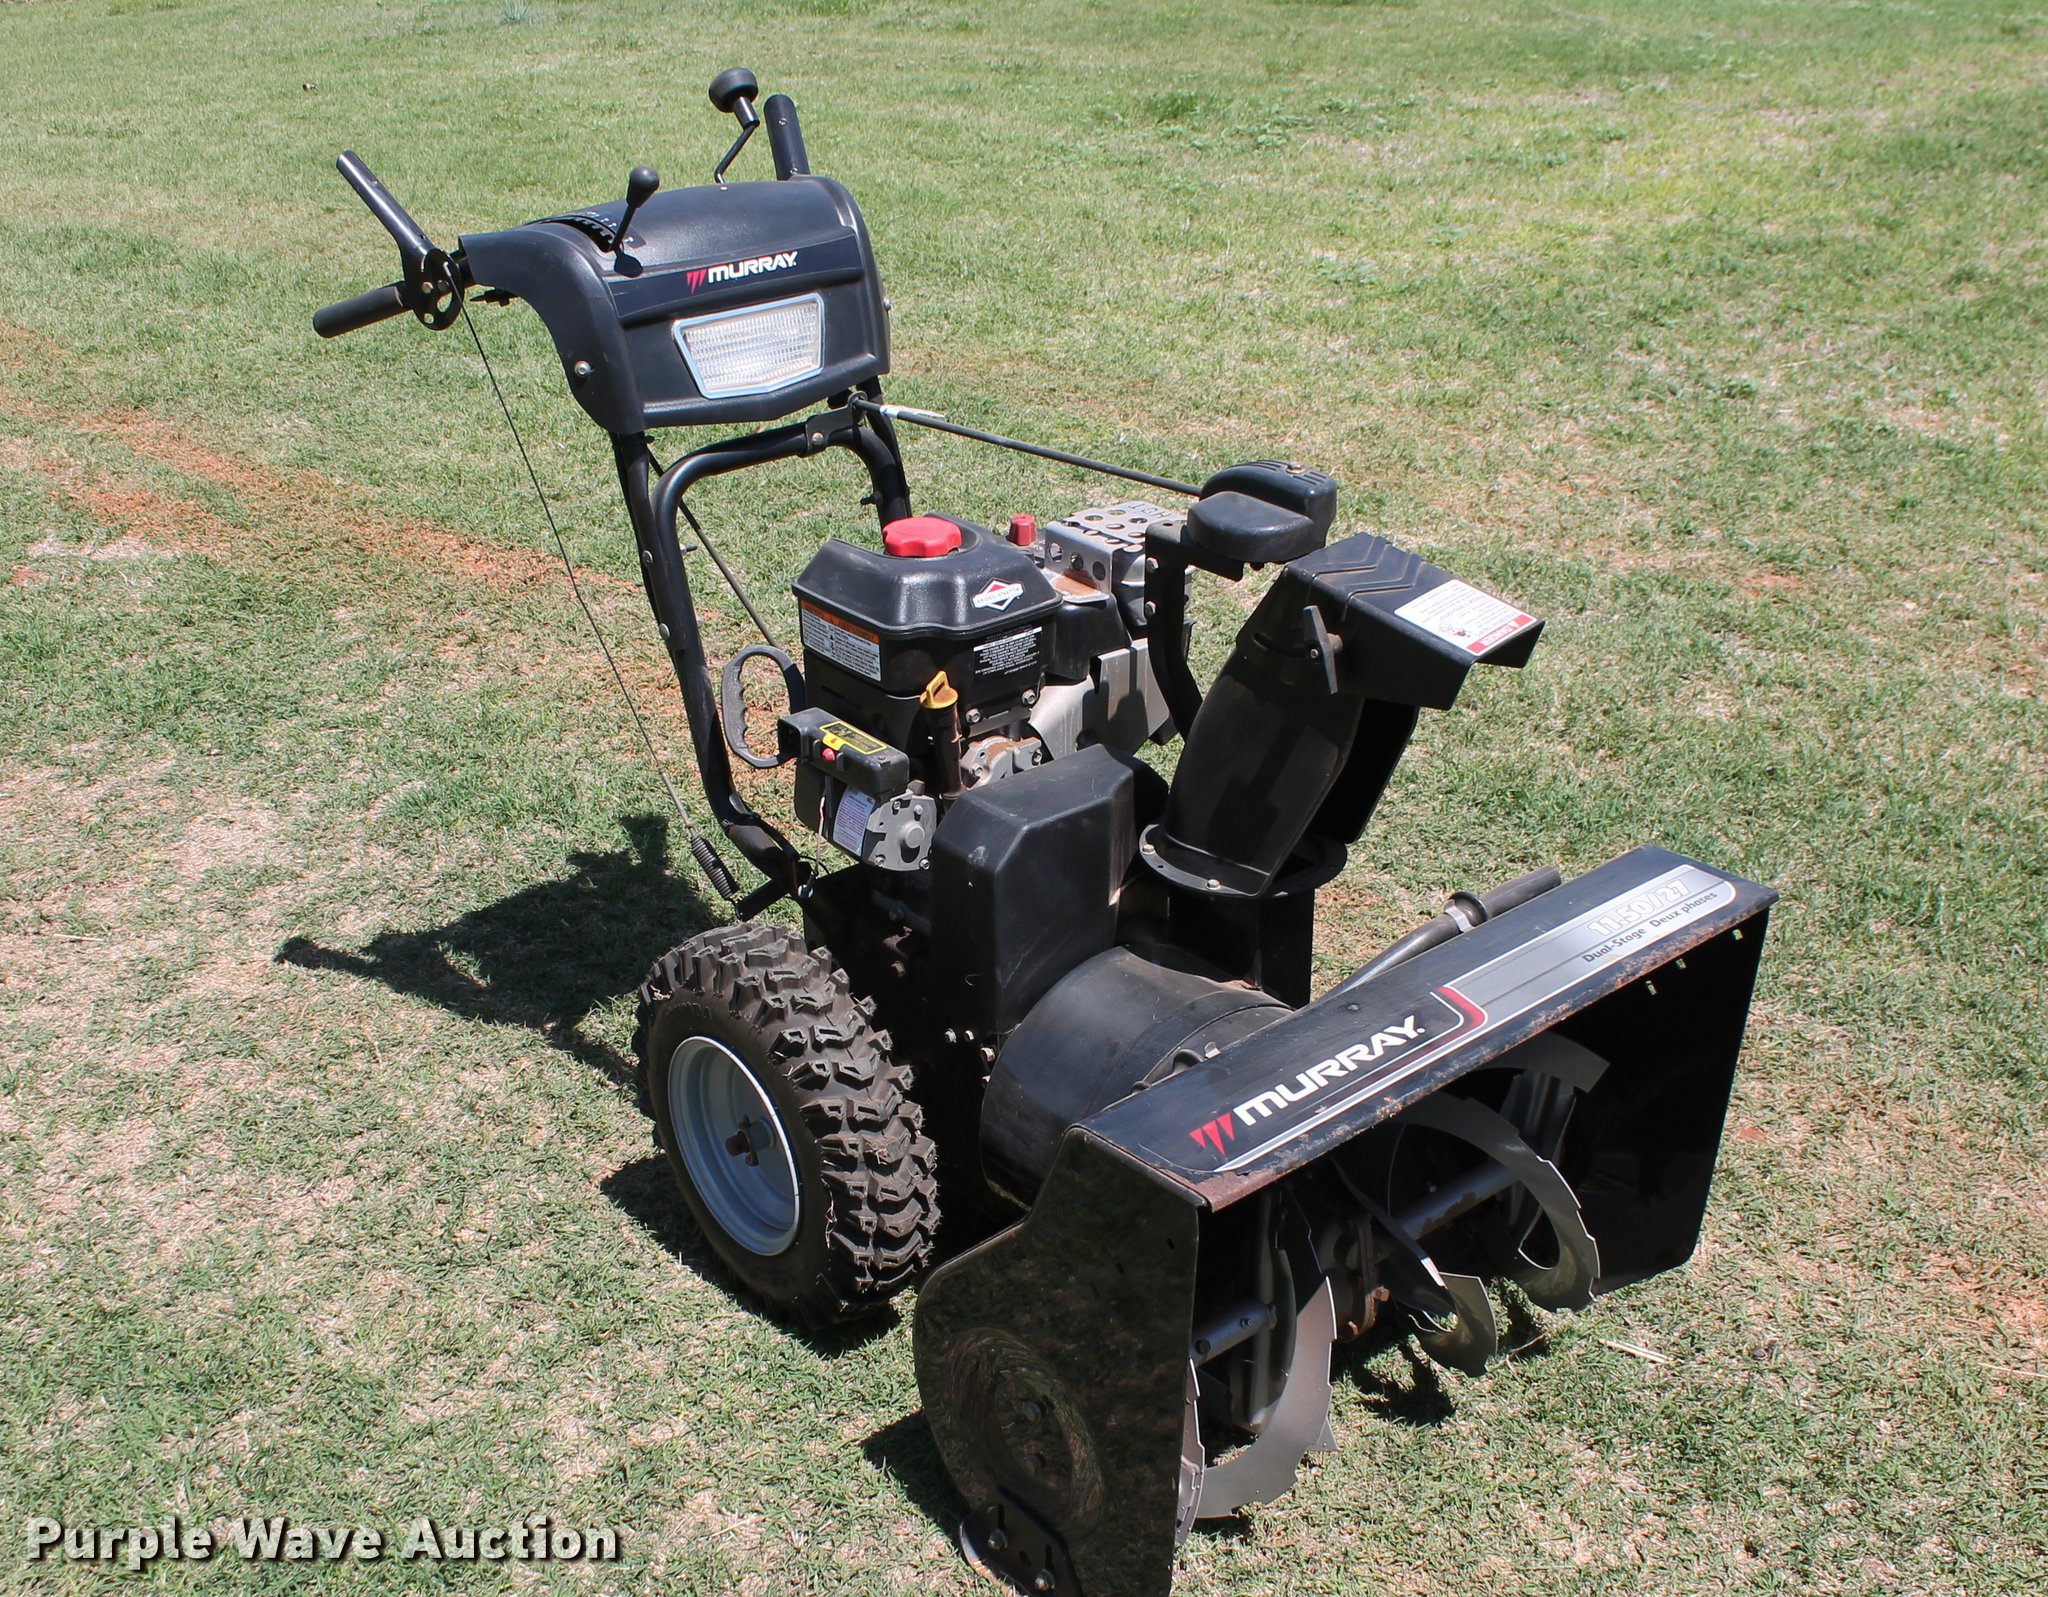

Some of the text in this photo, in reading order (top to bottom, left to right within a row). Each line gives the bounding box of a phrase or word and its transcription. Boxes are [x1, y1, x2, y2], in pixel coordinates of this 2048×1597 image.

[708, 251, 798, 284] MURRAY
[1582, 892, 1718, 963] Dual-Stage Deux phases
[1586, 879, 1691, 937] 11.50/27
[1233, 1015, 1424, 1127] MURRAY
